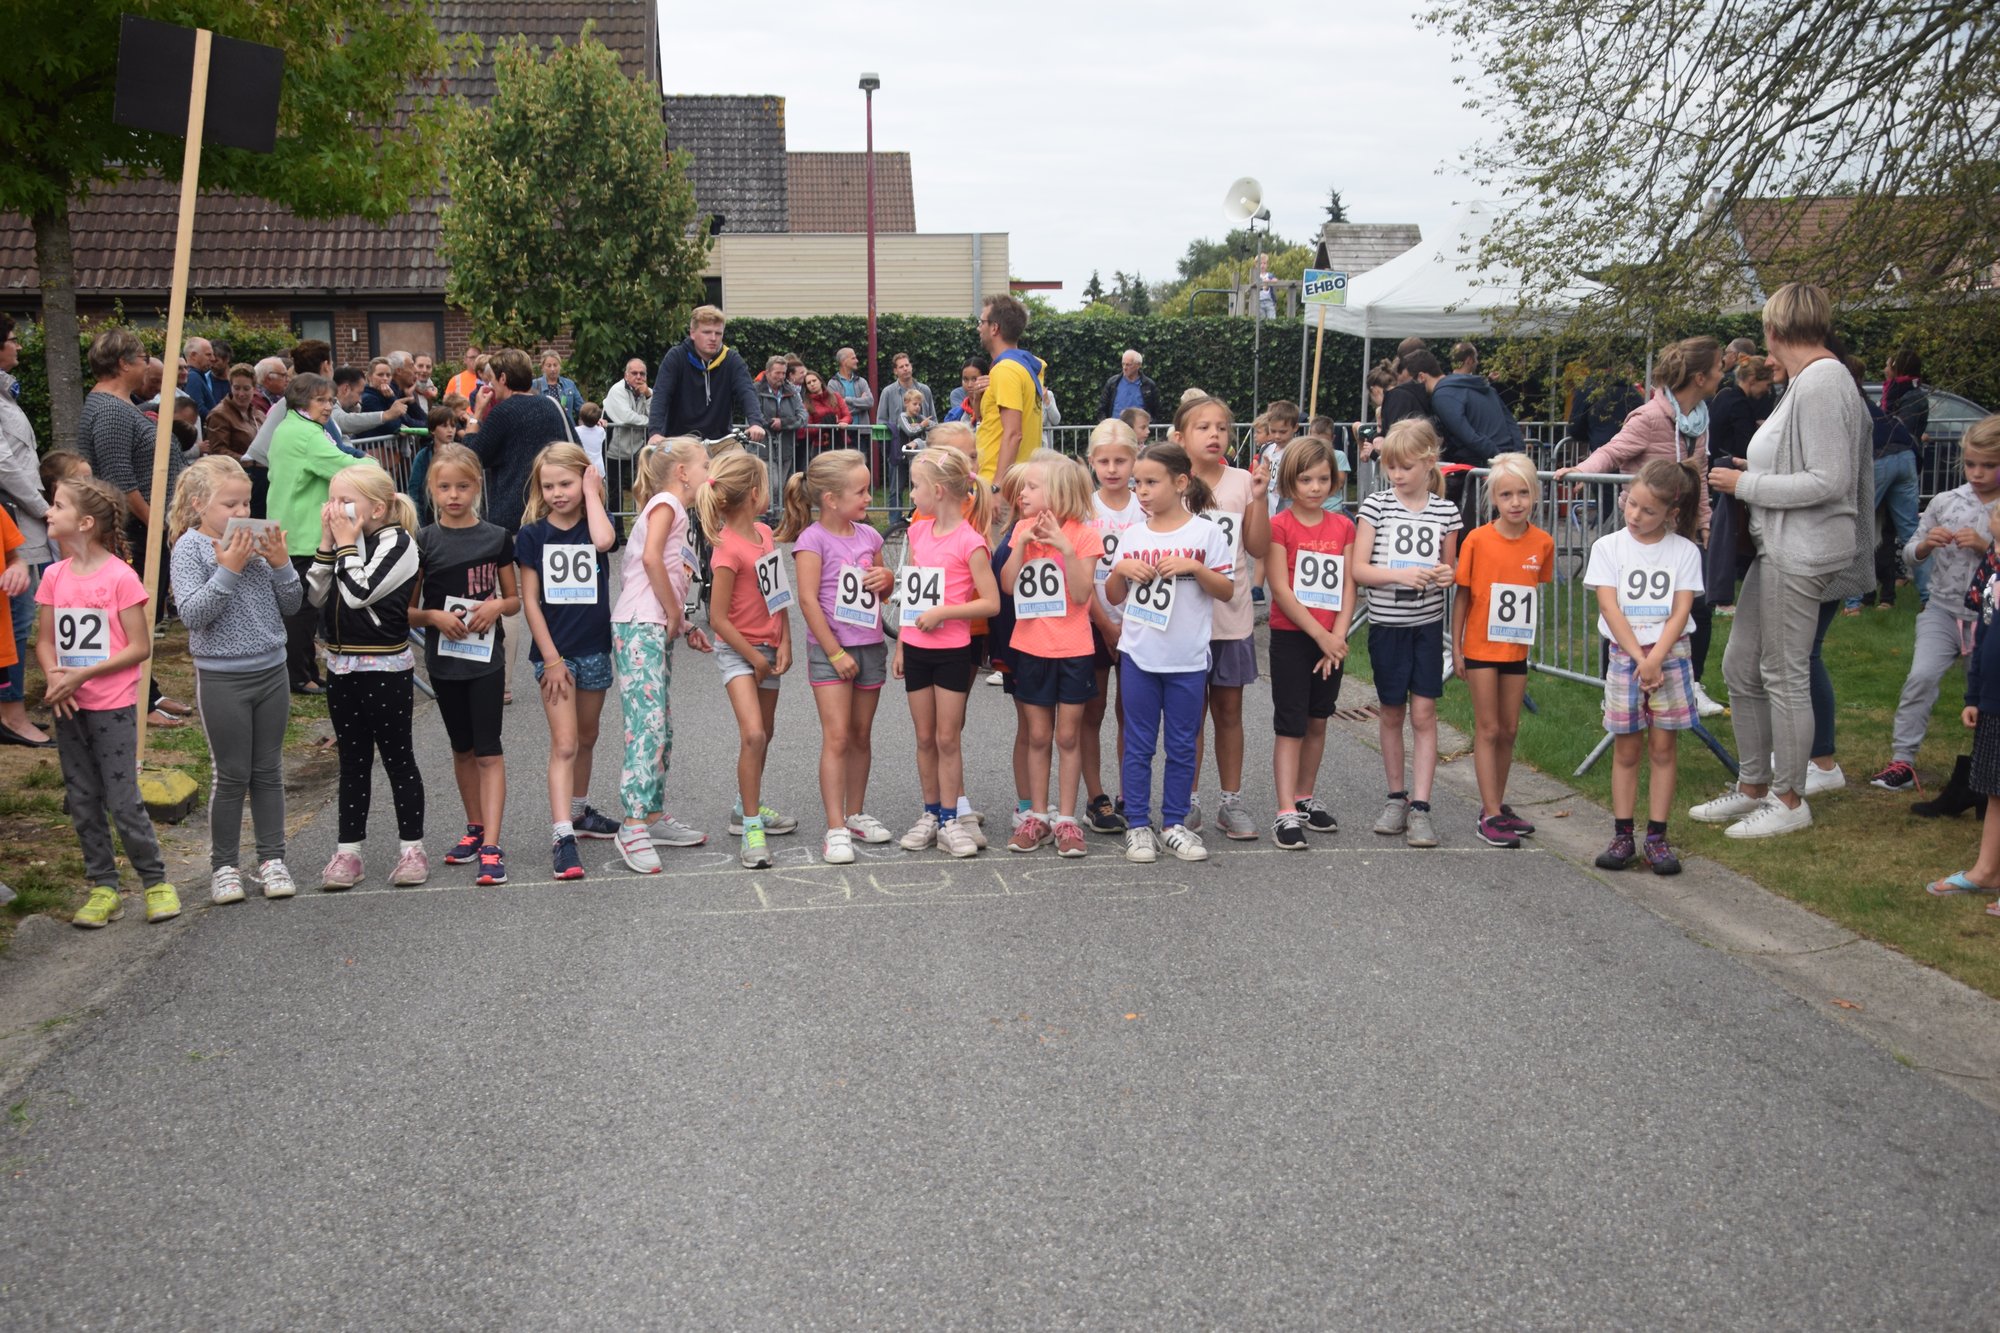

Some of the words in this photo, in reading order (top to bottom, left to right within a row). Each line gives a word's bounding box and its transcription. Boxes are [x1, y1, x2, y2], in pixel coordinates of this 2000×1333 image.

[1305, 277, 1346, 295] EHBO
[1101, 535, 1119, 566] 9
[1395, 524, 1434, 557] 88
[467, 563, 497, 596] NIK
[549, 550, 592, 583] 96
[758, 555, 780, 596] 87
[1019, 562, 1059, 598] 86
[1300, 555, 1338, 590] 98
[842, 572, 876, 609] 95
[907, 572, 940, 606] 94
[1135, 579, 1172, 611] 85
[1627, 570, 1670, 600] 99
[1498, 590, 1532, 624] 81
[59, 614, 102, 650] 92
